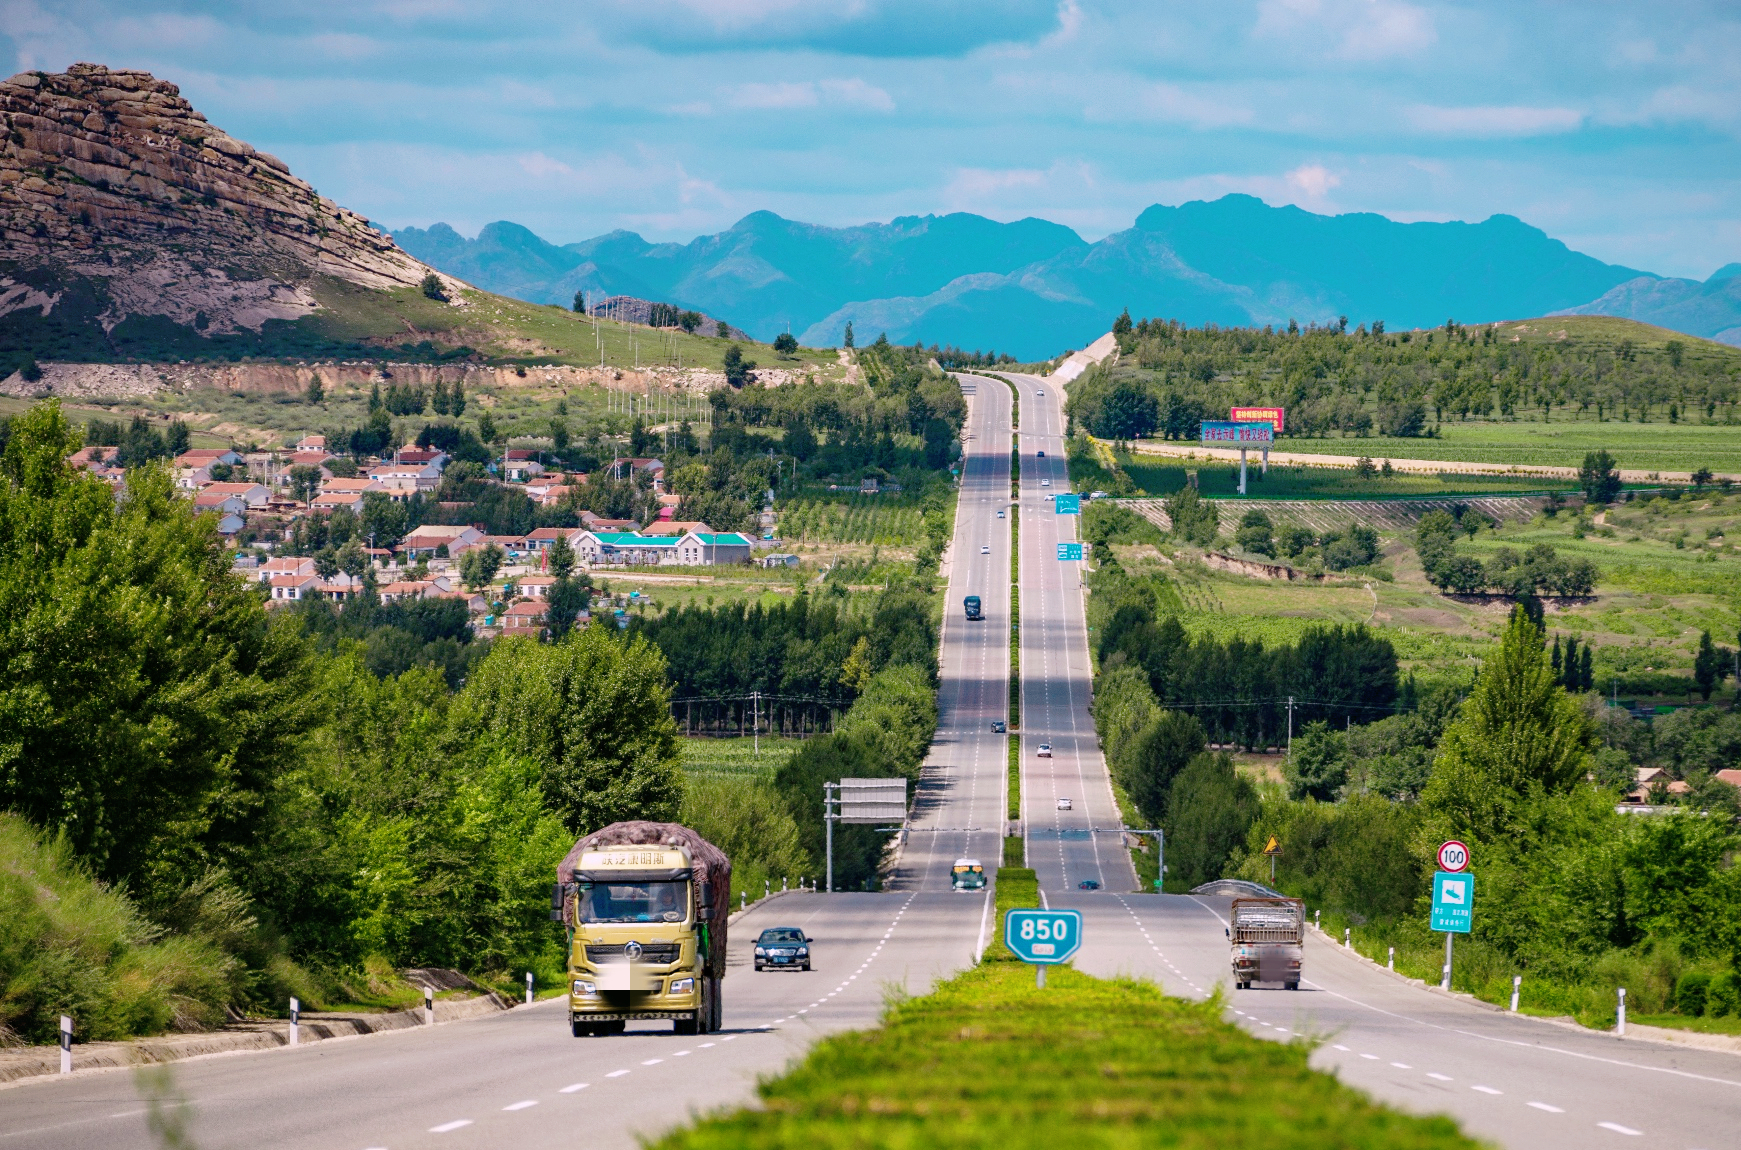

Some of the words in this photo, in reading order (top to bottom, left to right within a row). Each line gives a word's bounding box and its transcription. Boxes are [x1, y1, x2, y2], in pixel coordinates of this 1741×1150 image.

[602, 852, 665, 866] 陕汽康明斯
[1444, 850, 1464, 864] 100
[1020, 919, 1067, 941] 850
